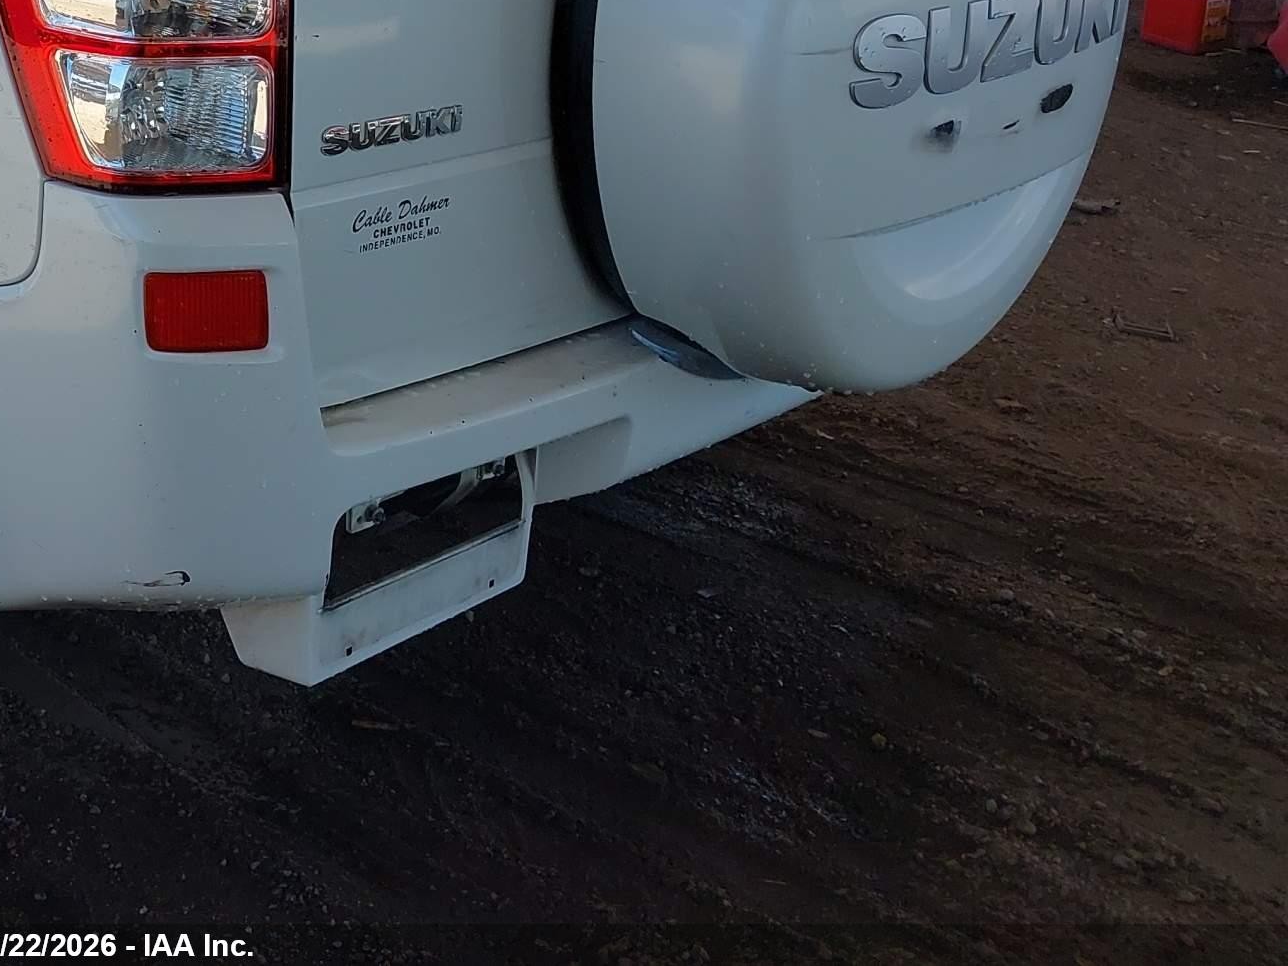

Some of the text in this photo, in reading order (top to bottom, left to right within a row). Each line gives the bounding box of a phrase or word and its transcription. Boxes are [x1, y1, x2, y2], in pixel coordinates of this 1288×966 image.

[319, 104, 464, 157] SUZUKI
[352, 195, 451, 234] Cable Dahmer
[373, 216, 432, 239] CHEVROLET
[359, 231, 427, 254] INDEPENDENCE,
